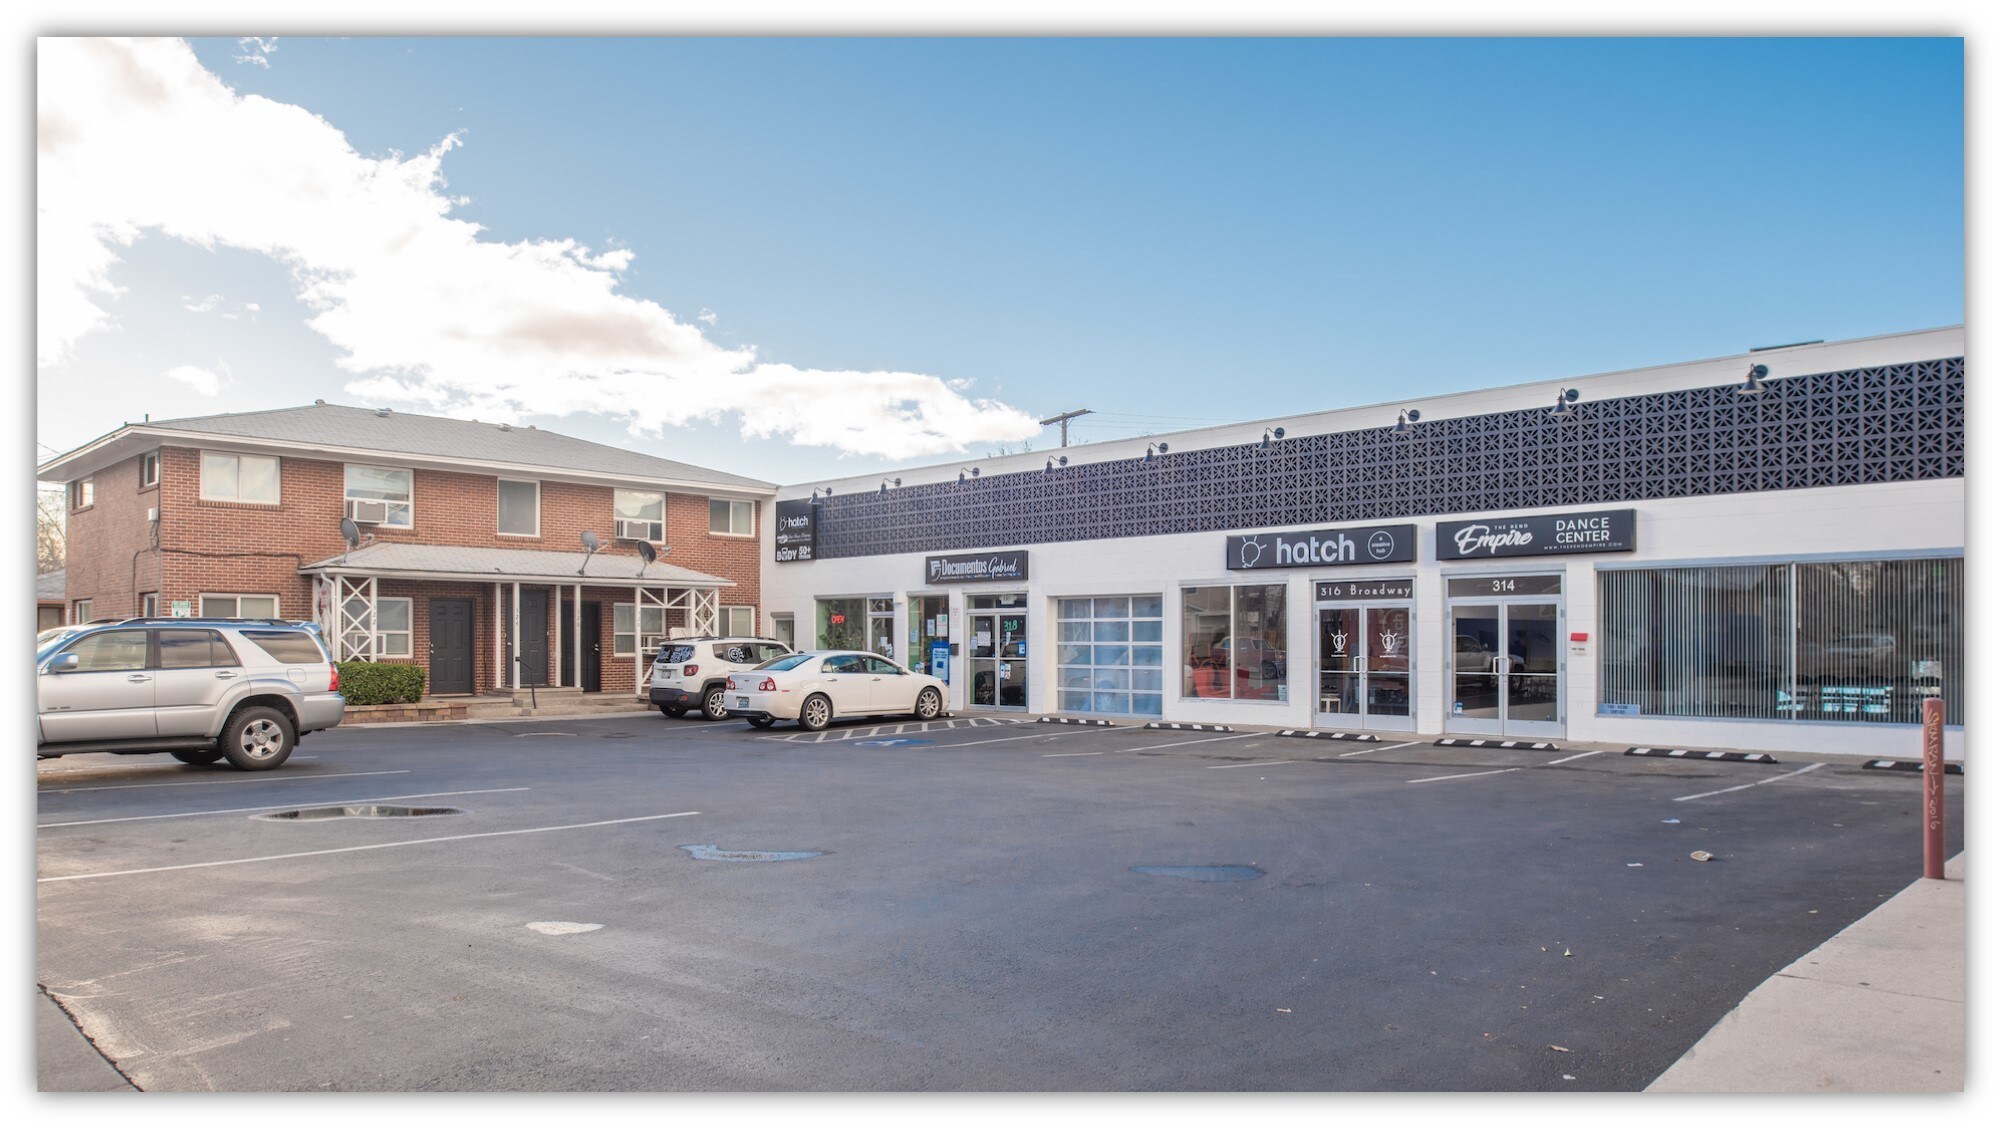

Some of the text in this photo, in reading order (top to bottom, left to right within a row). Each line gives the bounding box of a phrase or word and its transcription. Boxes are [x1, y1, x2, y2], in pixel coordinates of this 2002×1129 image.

[788, 515, 808, 527] hatch
[1556, 517, 1610, 532] DANCE
[1454, 524, 1533, 555] Empire
[1556, 530, 1610, 544] CENTER
[1276, 533, 1356, 564] hatch
[941, 559, 987, 576] Documentos
[988, 556, 1017, 579] Gabriel
[1320, 584, 1411, 597] 316 Broadway
[1492, 580, 1515, 592] 314
[831, 615, 845, 624] OPEN
[1004, 620, 1017, 631] 318
[1929, 799, 1940, 830] 2016
